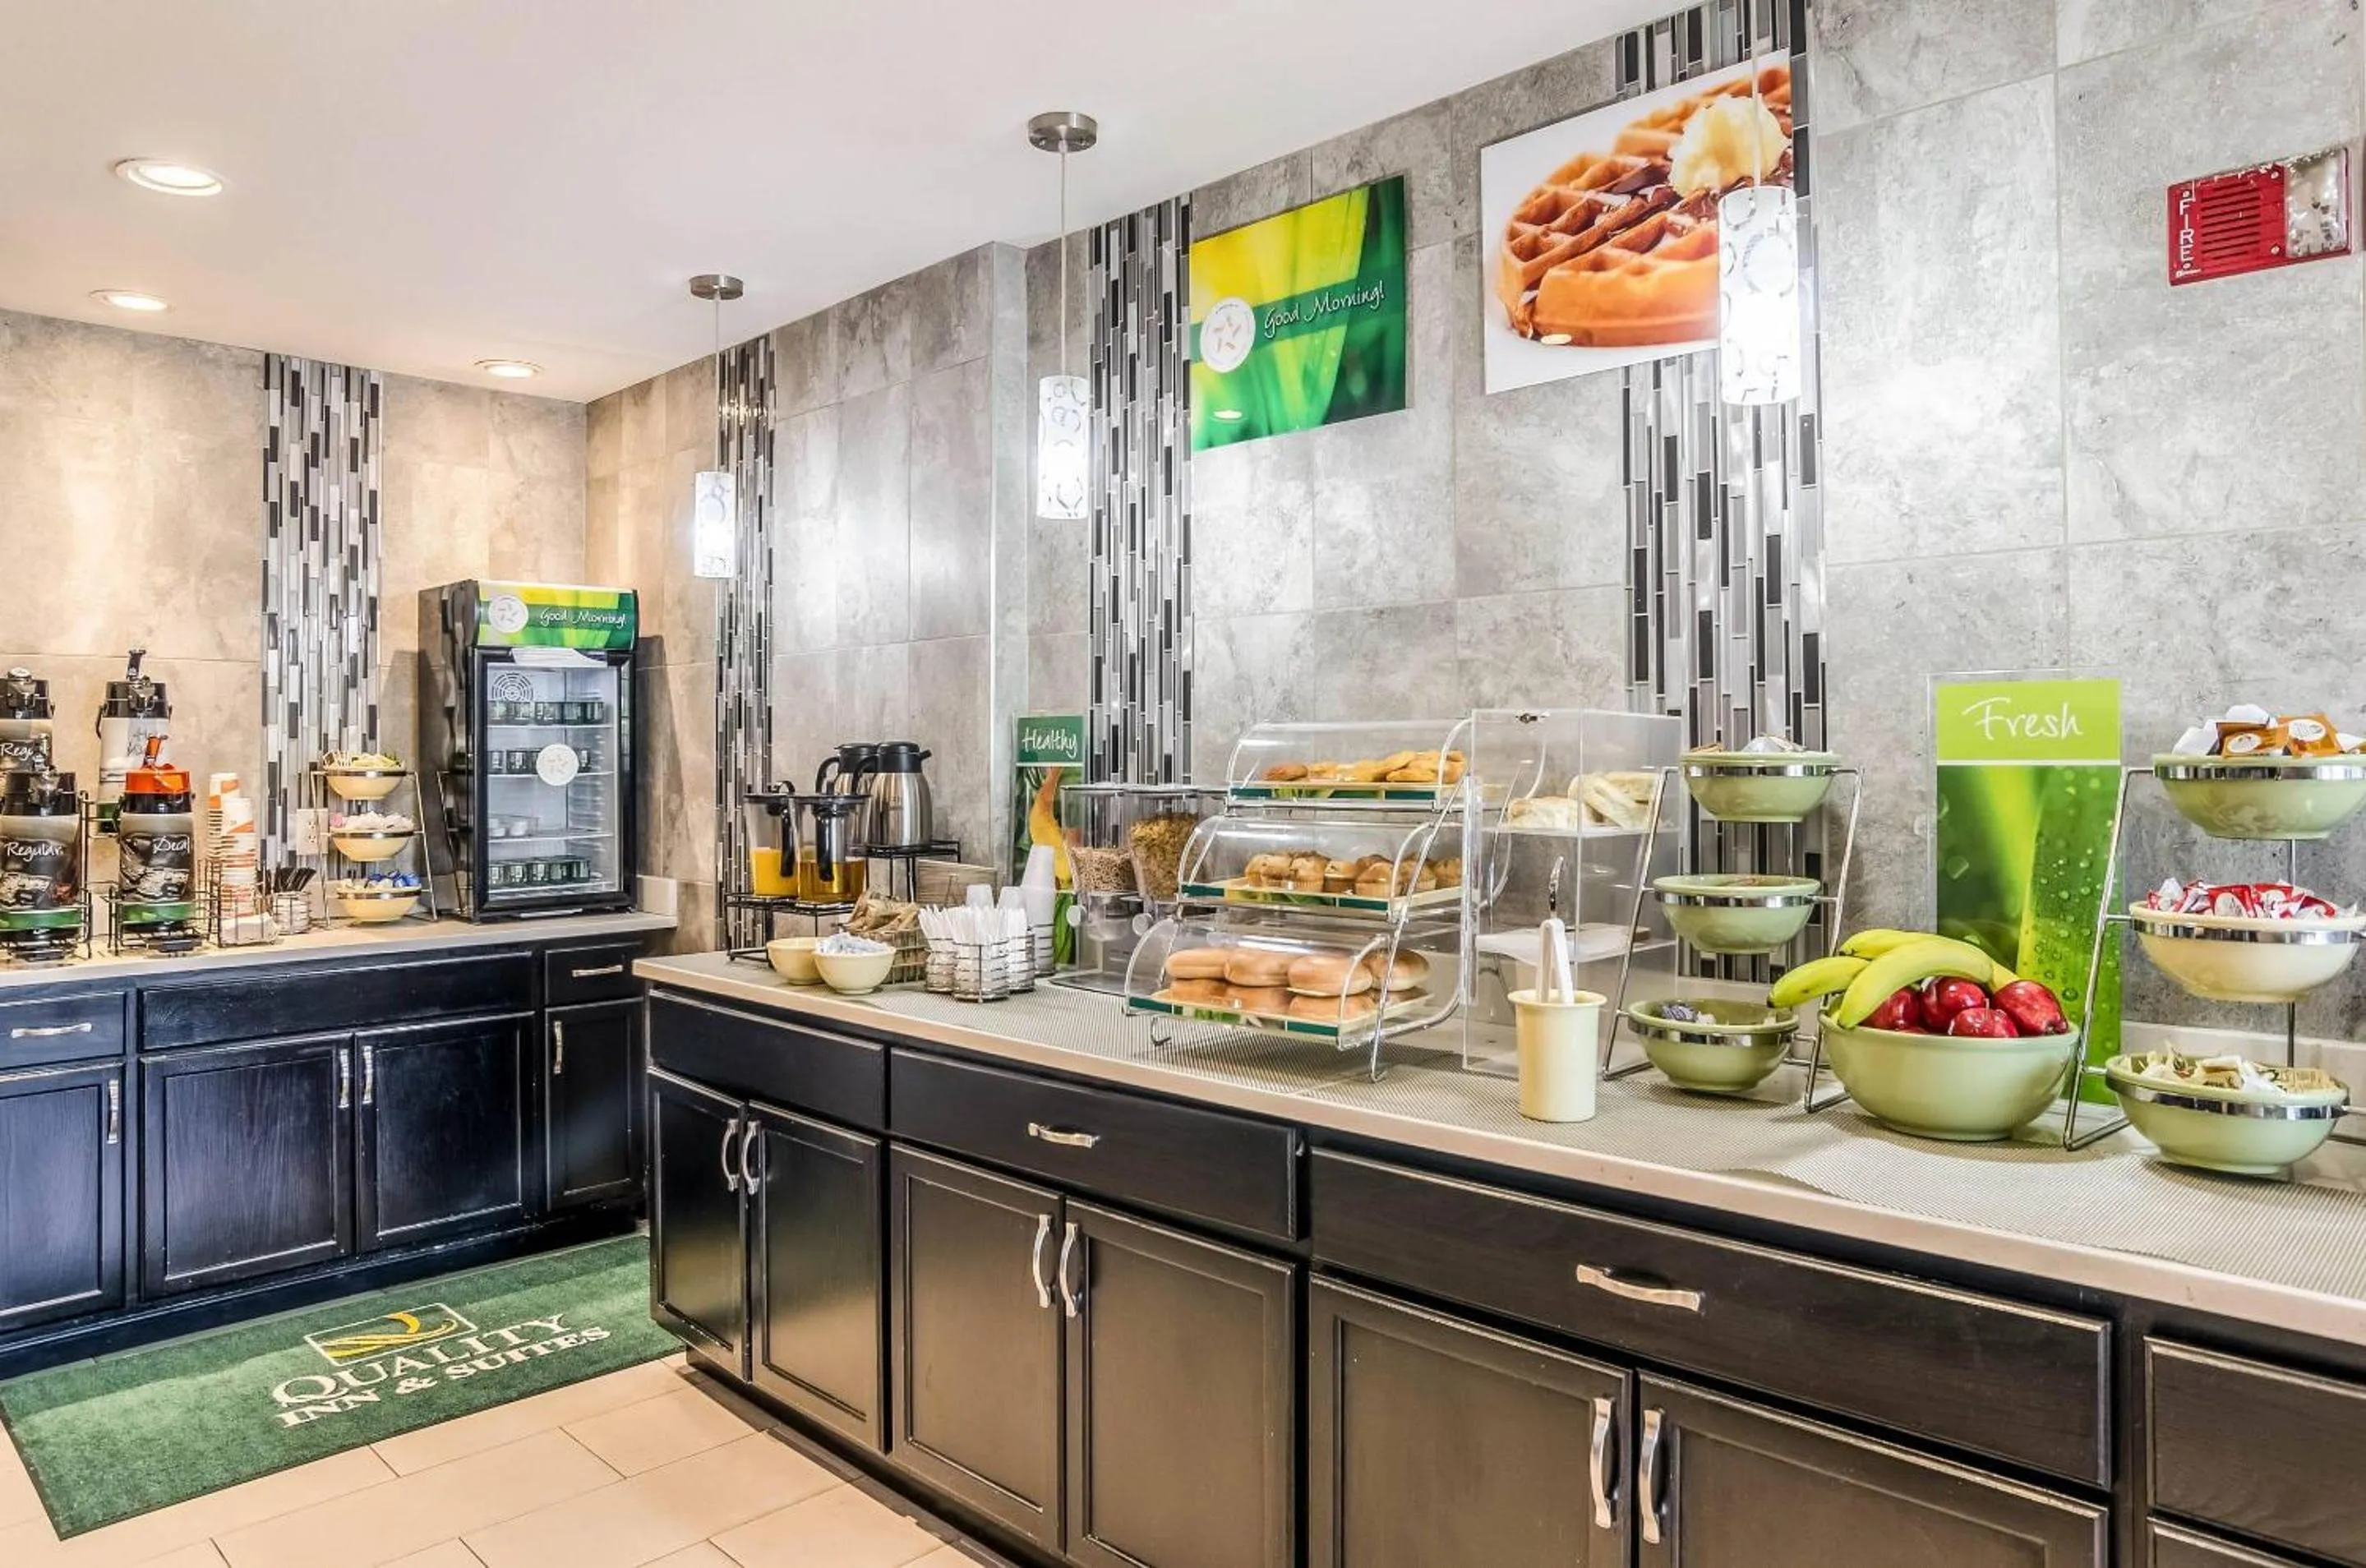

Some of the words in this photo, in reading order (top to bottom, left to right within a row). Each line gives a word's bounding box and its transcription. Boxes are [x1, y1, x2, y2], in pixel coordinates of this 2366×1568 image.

[2179, 198, 2194, 261] FIRE
[1264, 302, 1300, 339] Good
[1304, 279, 1385, 322] Morning!
[540, 606, 568, 627] Good
[1022, 728, 1078, 759] Healthy
[1961, 696, 2083, 740] Fresh
[4, 841, 65, 862] Regular
[272, 1313, 571, 1406] QUALITY
[275, 1389, 380, 1428] INN
[395, 1377, 438, 1395] &
[449, 1326, 611, 1381] SUITES
